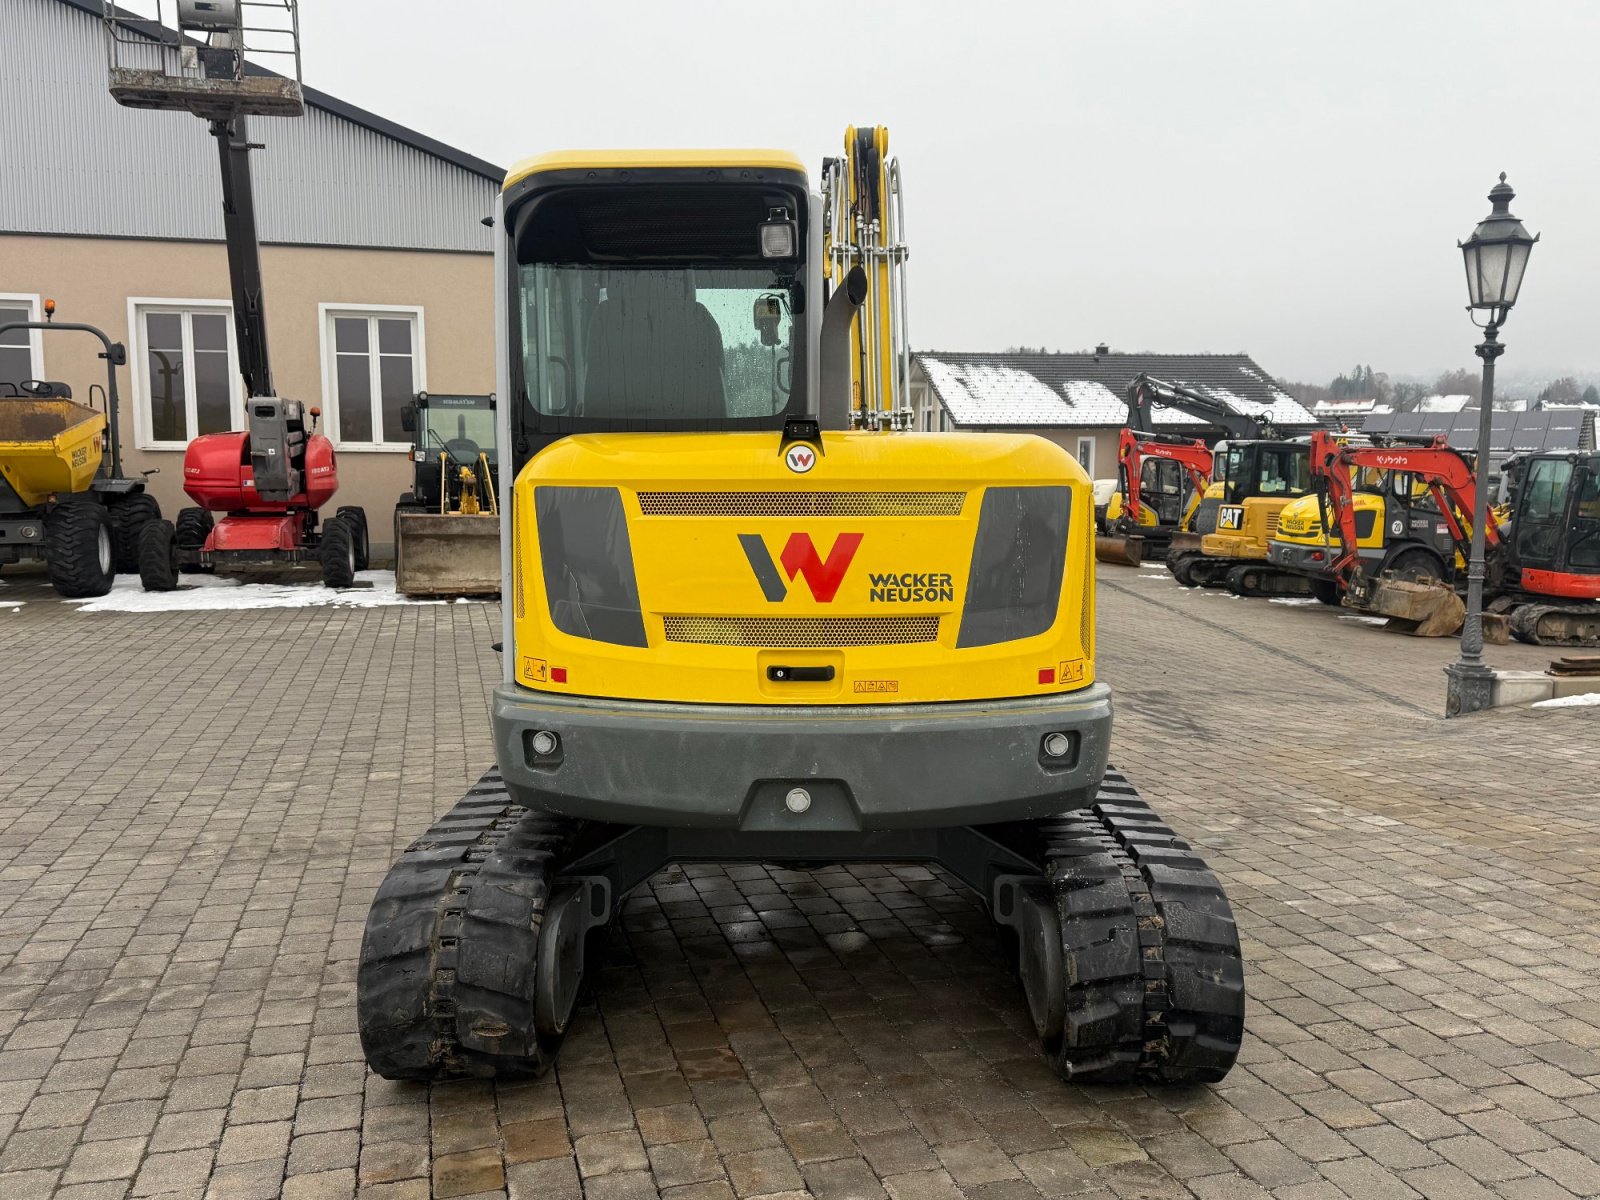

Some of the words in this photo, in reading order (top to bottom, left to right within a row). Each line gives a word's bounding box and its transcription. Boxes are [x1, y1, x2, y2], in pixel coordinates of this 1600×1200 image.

[72, 447, 87, 458] WACKER
[1376, 456, 1408, 465] Kubota
[1220, 508, 1242, 529] CAT
[868, 573, 954, 588] WACKER
[870, 587, 954, 602] NEUSON
